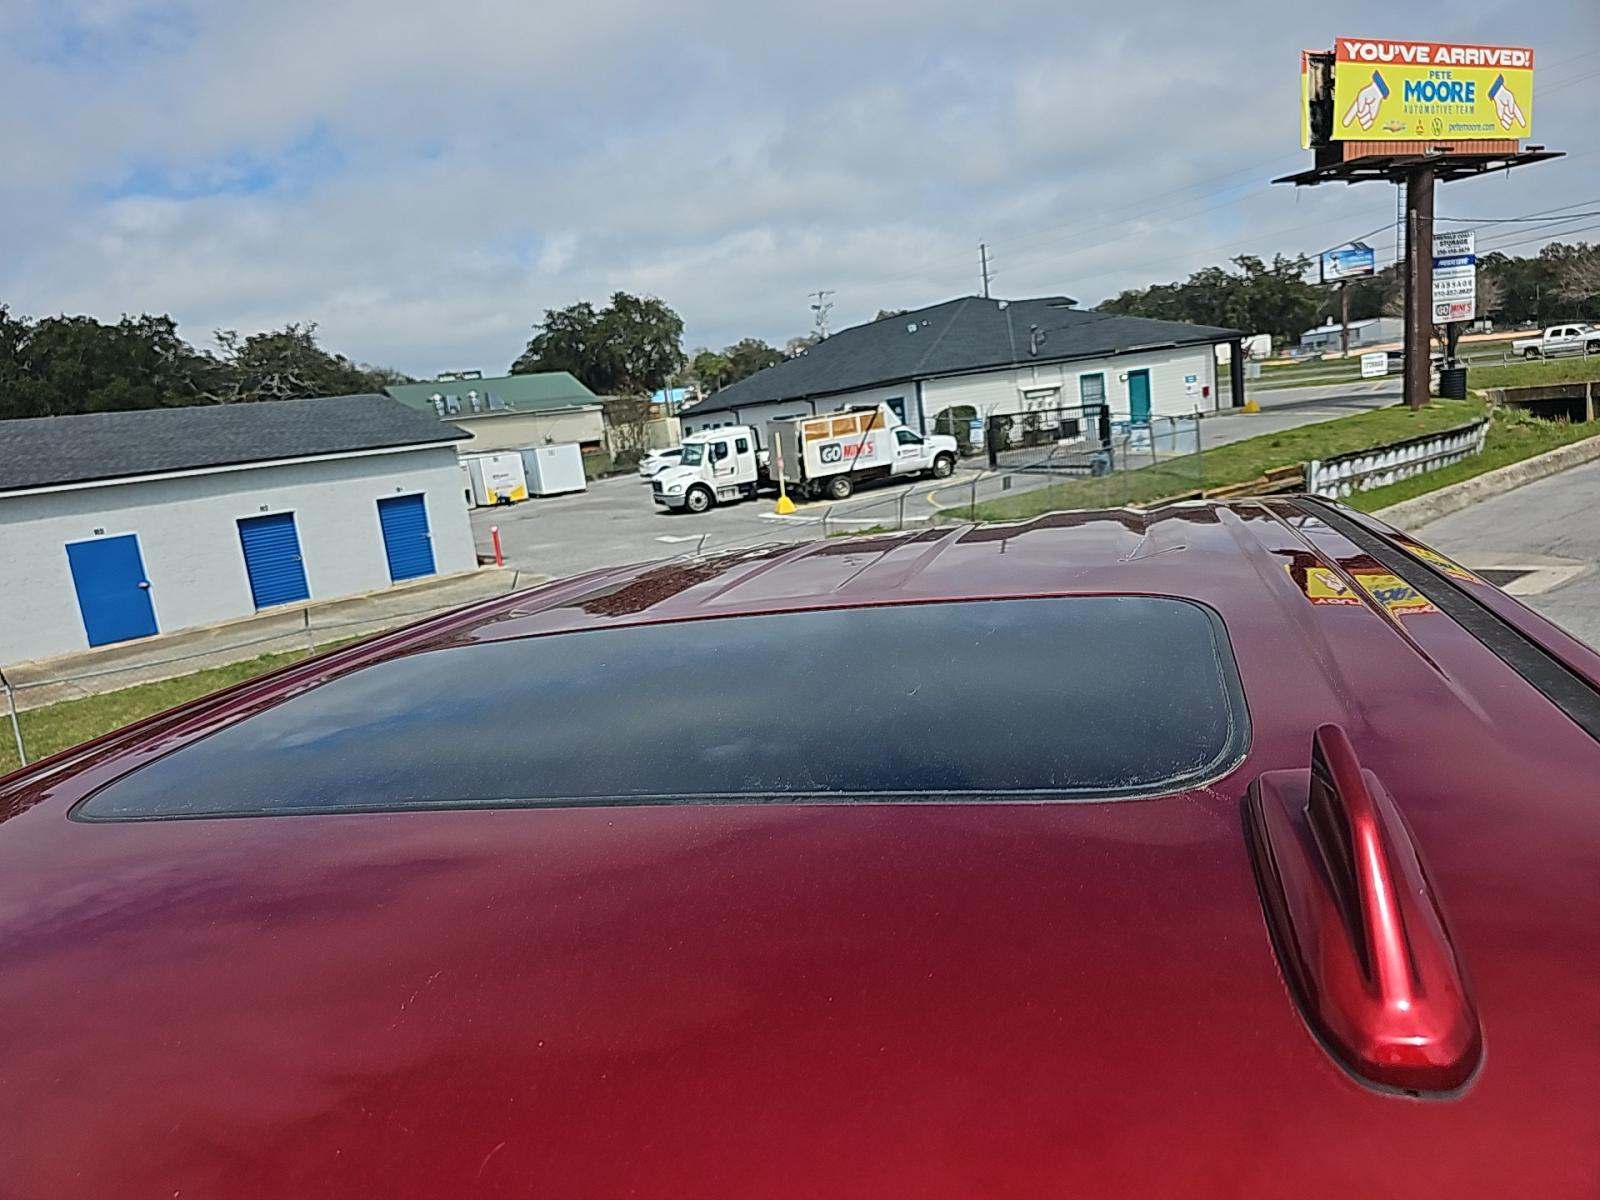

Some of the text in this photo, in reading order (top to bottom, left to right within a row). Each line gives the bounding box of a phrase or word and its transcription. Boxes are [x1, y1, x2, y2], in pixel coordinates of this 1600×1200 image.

[1343, 41, 1530, 67] YOU'VE ARRIVED!
[1429, 70, 1452, 80] PETE
[1404, 80, 1475, 103] MOORE
[1404, 104, 1475, 114] AUTOMOTIVE TEAM
[822, 446, 841, 462] GO
